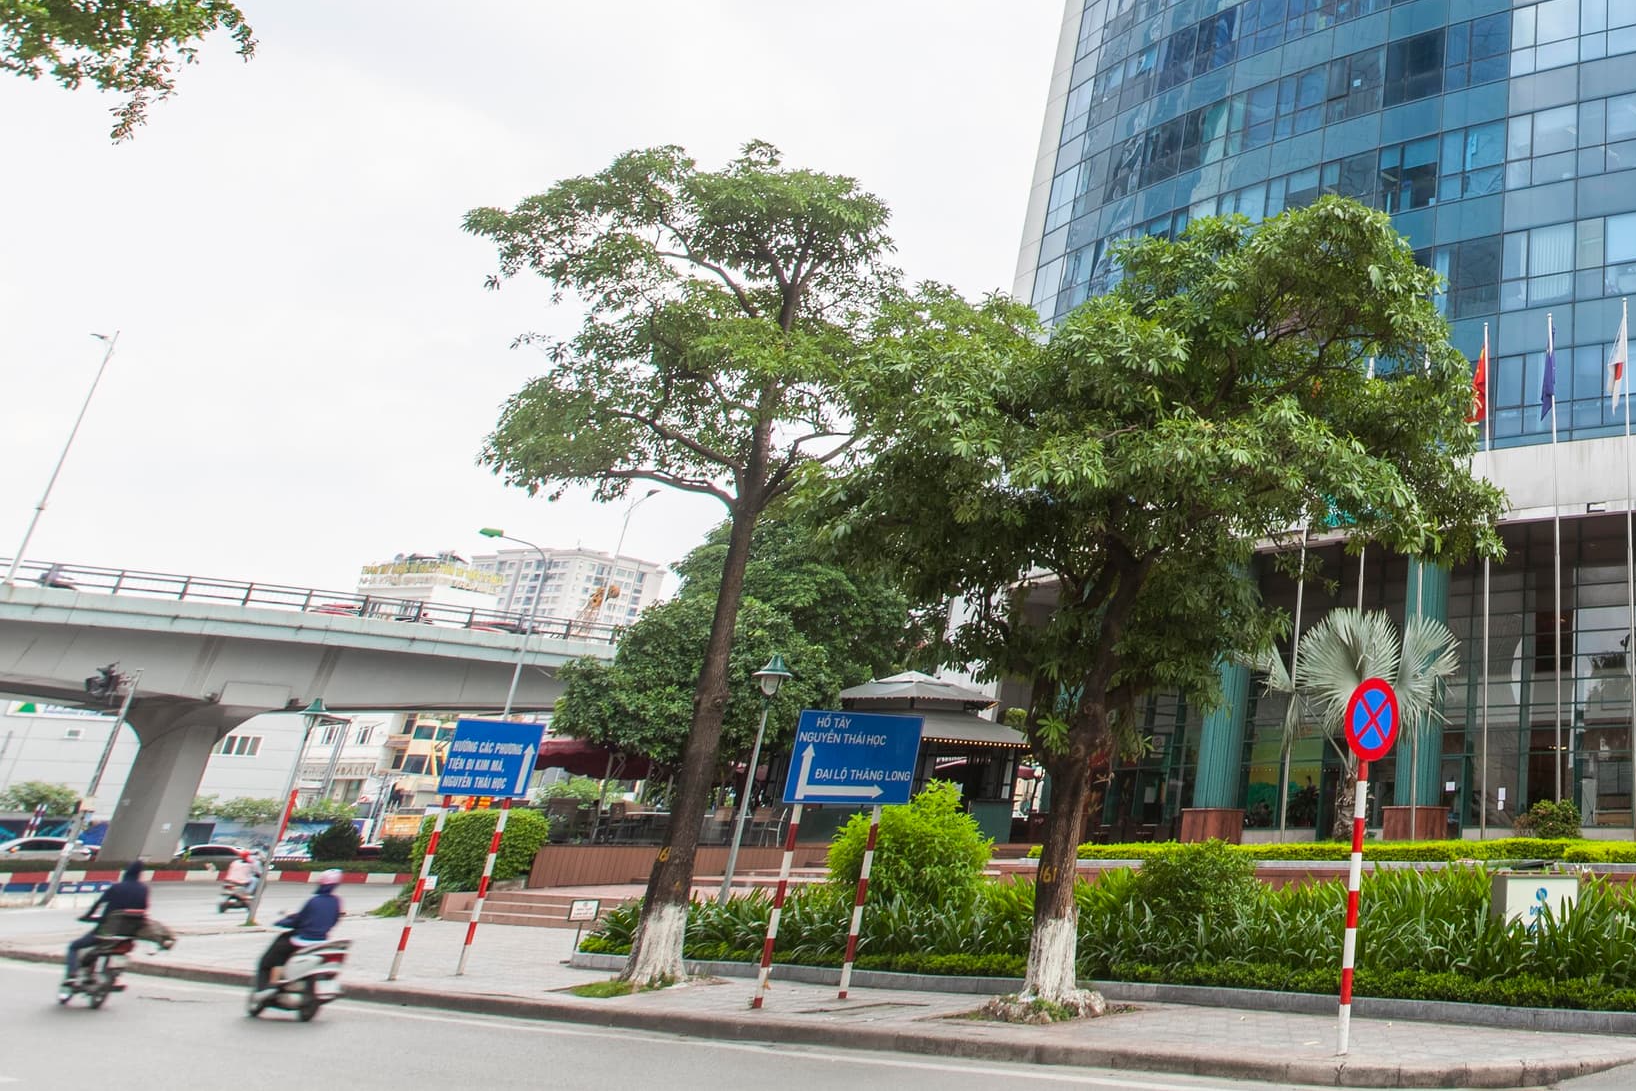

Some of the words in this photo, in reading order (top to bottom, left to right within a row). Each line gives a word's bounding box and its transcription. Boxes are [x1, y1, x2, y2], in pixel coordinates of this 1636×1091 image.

[834, 716, 852, 729] TÂY
[843, 731, 866, 744] THÁI
[867, 734, 887, 748] HỌC
[479, 740, 494, 754] CÁC
[475, 759, 490, 770] KIM
[815, 768, 833, 782] ĐẠI
[885, 771, 911, 782] LONG
[474, 775, 492, 789] THÁI
[491, 777, 507, 791] HỌC
